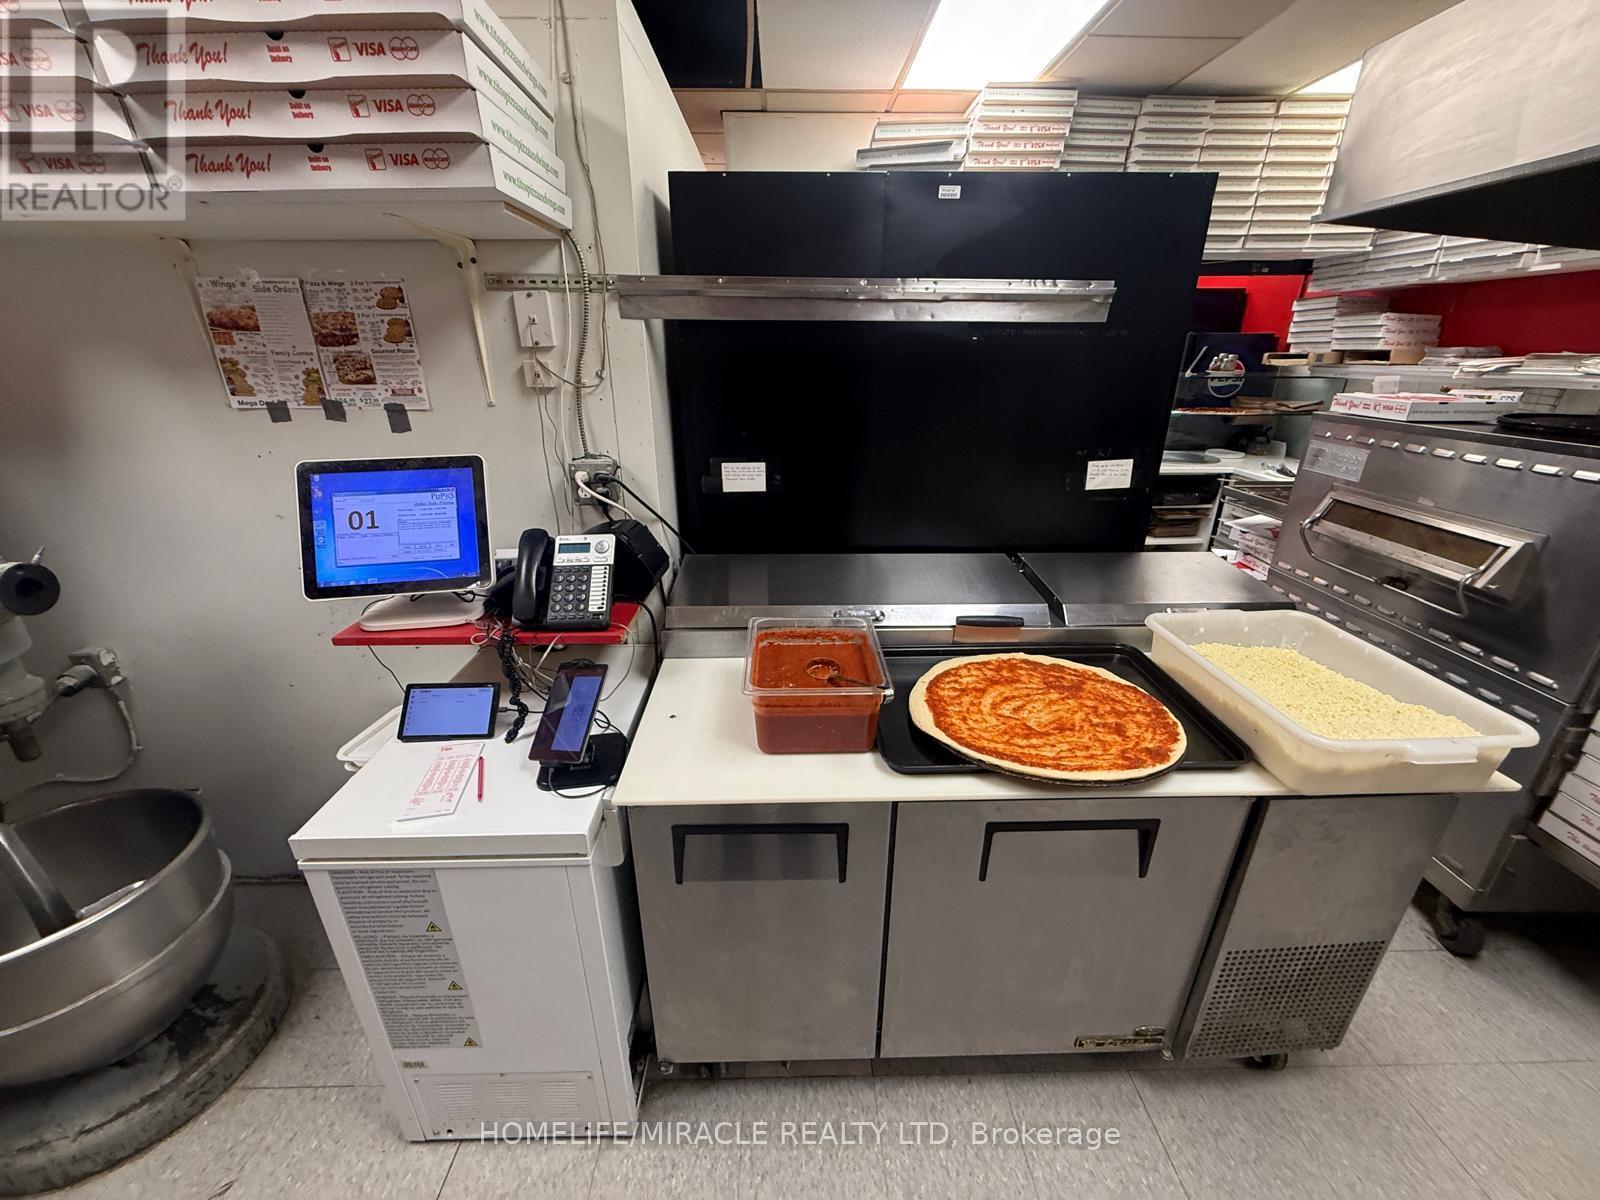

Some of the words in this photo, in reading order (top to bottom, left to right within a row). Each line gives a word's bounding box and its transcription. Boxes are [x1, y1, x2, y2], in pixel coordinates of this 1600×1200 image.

[353, 42, 387, 56] VISA
[0, 52, 19, 66] SA
[135, 42, 188, 66] Thank
[189, 42, 228, 72] You!
[20, 104, 54, 118] VISA
[371, 99, 405, 112] VISA
[163, 99, 213, 122] Thank
[214, 99, 251, 127] You!
[41, 157, 75, 170] VISA
[185, 153, 234, 173] Thank
[234, 153, 271, 179] You!
[388, 153, 419, 166] VISA
[209, 280, 236, 289] Wings
[252, 285, 271, 293] Side
[273, 285, 300, 293] Orders
[1383, 403, 1394, 411] VISA
[347, 510, 380, 530] 01
